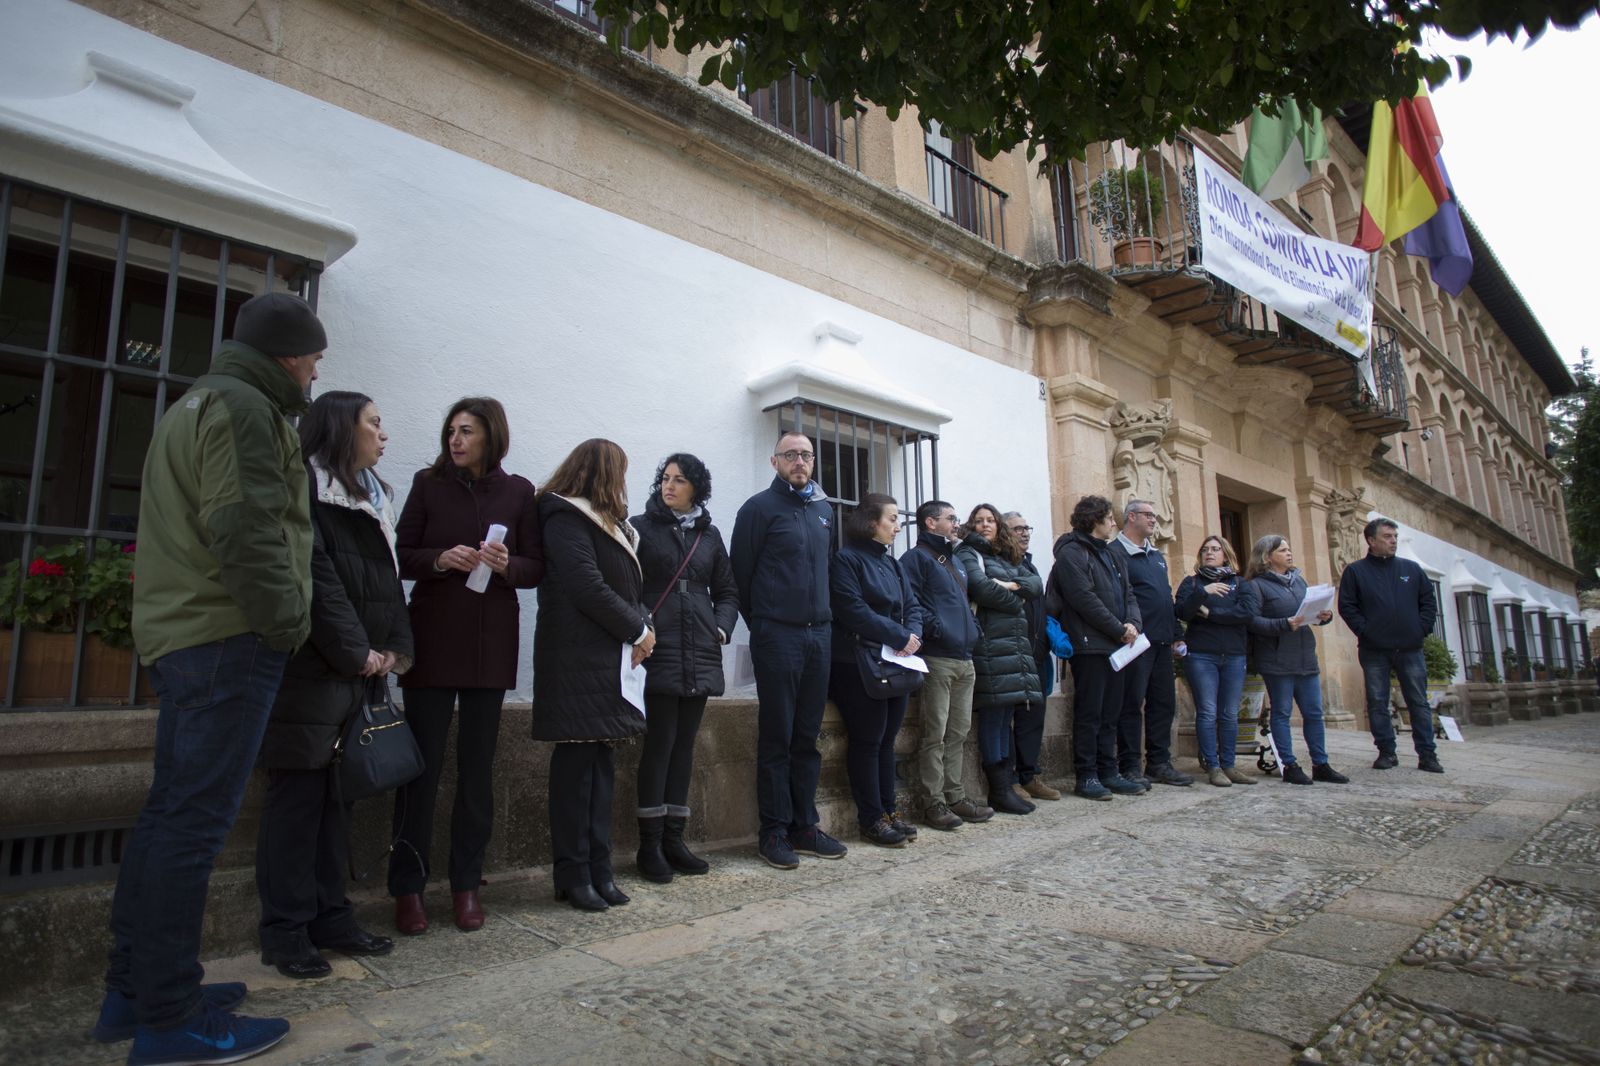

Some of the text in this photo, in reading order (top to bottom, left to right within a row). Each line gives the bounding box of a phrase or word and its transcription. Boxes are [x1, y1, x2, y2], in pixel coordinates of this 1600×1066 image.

[1204, 167, 1258, 237] RONDA
[1255, 211, 1317, 273] CONTRA
[1312, 246, 1344, 281] LA
[1209, 214, 1223, 240] Día
[1224, 223, 1267, 271] Internacional
